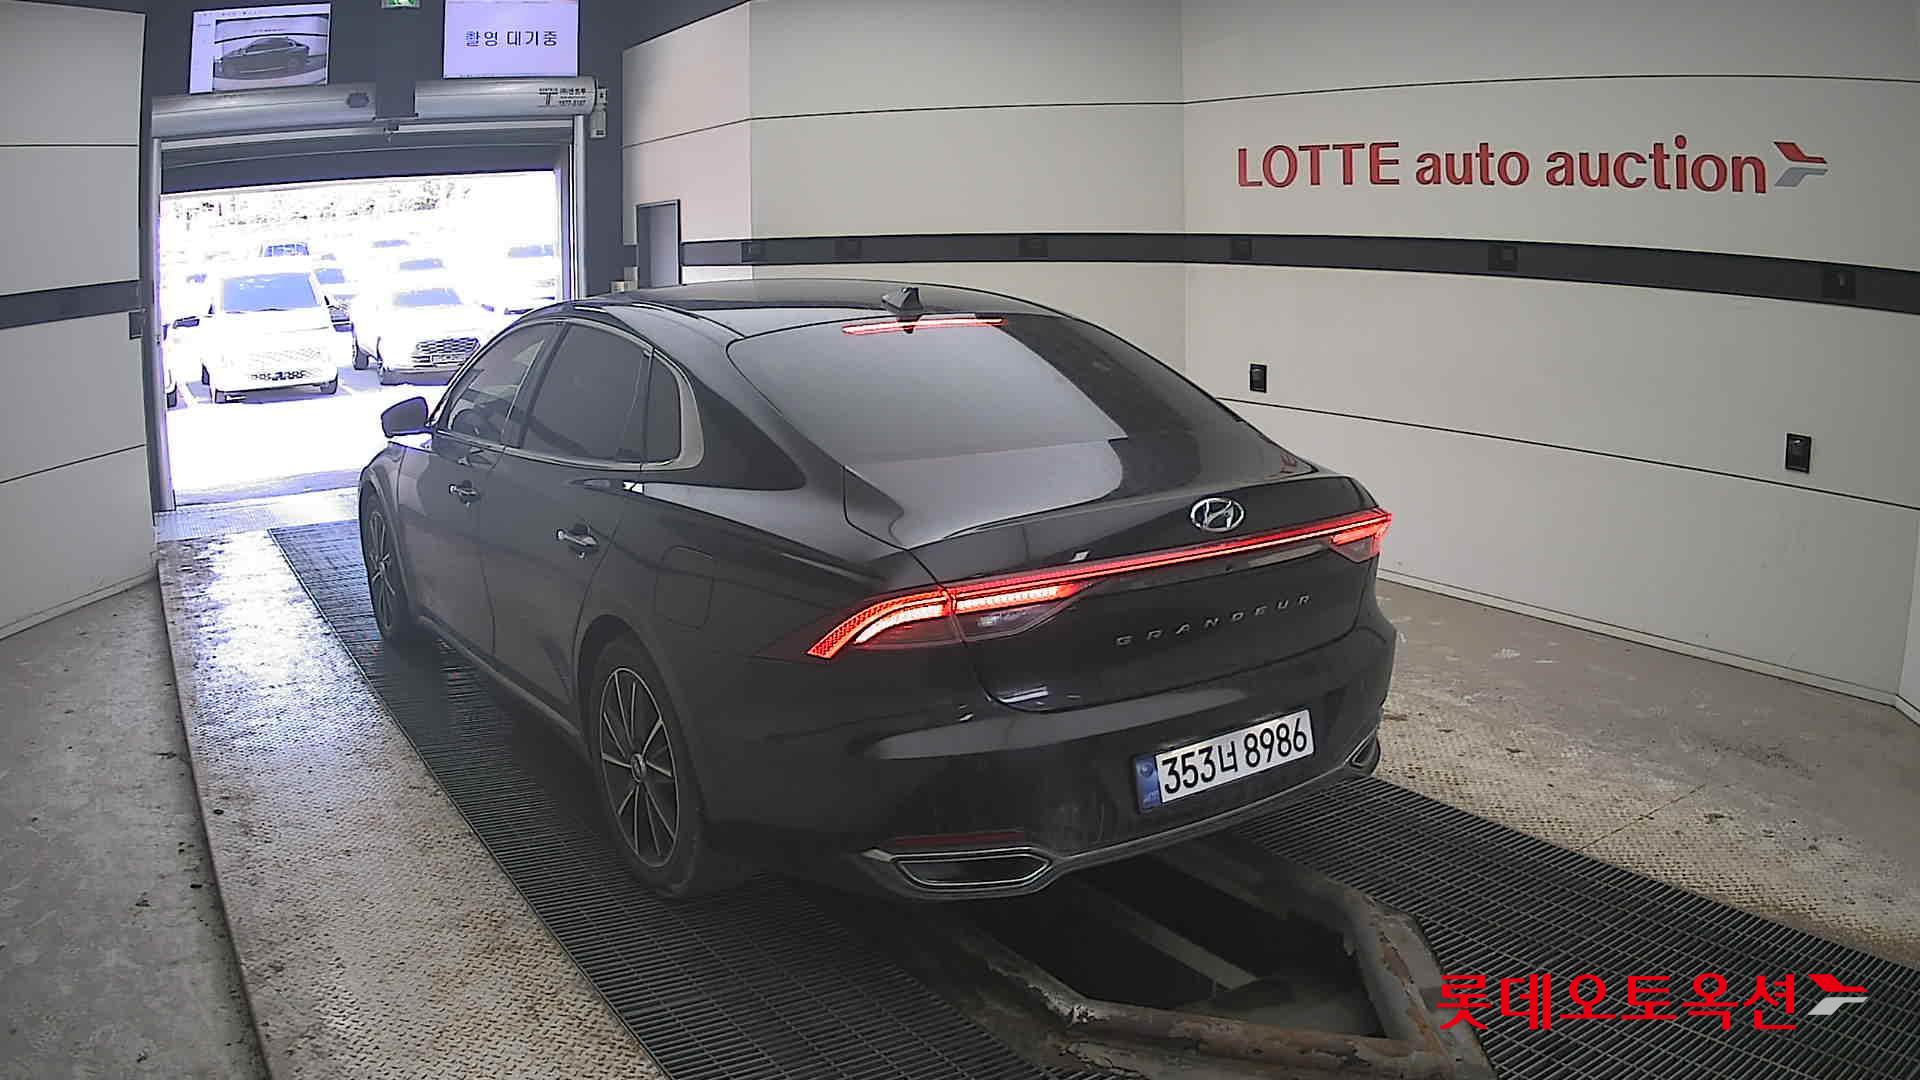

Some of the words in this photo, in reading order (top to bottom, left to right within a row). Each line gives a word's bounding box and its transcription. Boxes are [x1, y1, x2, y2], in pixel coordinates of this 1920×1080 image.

[1236, 141, 1400, 188] LOTTE
[1415, 142, 1531, 187] auto
[1545, 135, 1768, 195] auction
[1116, 594, 1311, 646] GRANDEUR
[1243, 717, 1308, 768] 8986
